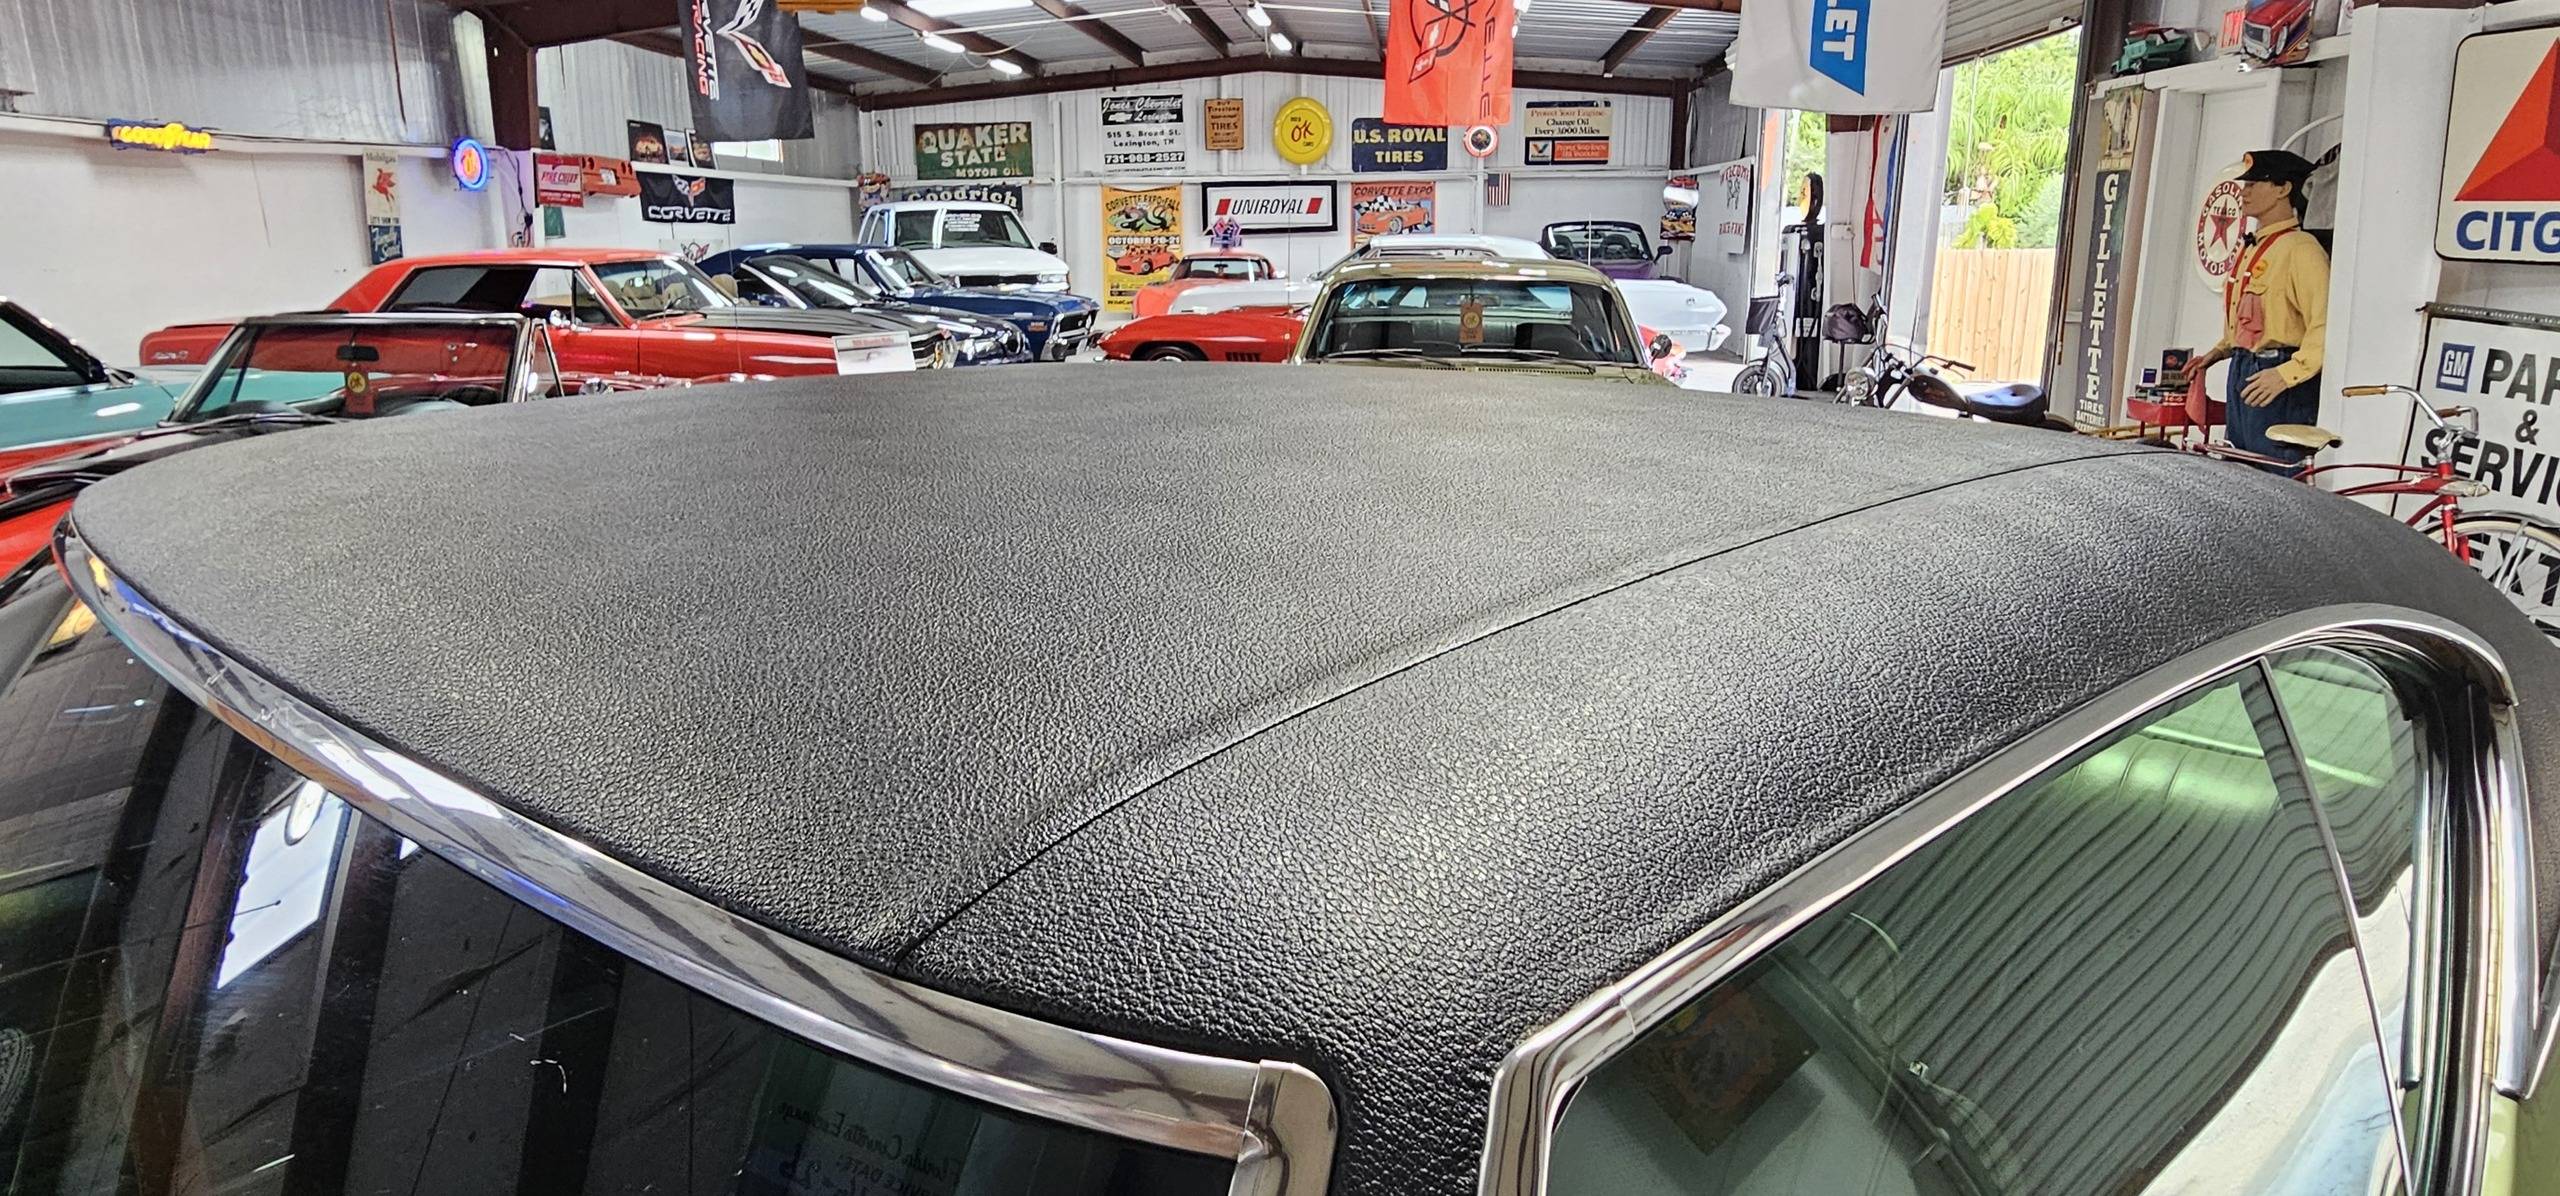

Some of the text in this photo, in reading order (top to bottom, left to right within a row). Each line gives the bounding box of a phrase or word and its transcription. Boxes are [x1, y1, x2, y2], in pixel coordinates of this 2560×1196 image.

[1135, 96, 1182, 111] Chevrolet
[1211, 122, 1238, 131] TIRES
[1546, 118, 1590, 126] Change Oil
[919, 123, 1029, 154] QUAKER
[1138, 129, 1164, 137] Broad
[1291, 120, 1314, 142] OK
[1353, 127, 1446, 144] U.S. ROYAL
[1534, 127, 1555, 136] Every
[1578, 126, 1600, 135] Miles
[940, 146, 1007, 168] STATE
[1375, 150, 1424, 163] TIRES
[955, 165, 1024, 178] MOTOR OIL
[1354, 184, 1434, 197] CORVETTE EXPO
[1105, 194, 1142, 212] CORVETTE
[1231, 198, 1304, 215] UNIROYAL
[2202, 182, 2245, 217] GASOLIN
[647, 206, 732, 222] CORVETTE
[1108, 235, 1181, 246] OCTOBER 20-21
[2086, 173, 2119, 399] GILLETTE
[2442, 349, 2470, 377] GM
[2080, 398, 2104, 415] TIRES
[2515, 409, 2540, 446] &
[2420, 428, 2560, 507] SERVI
